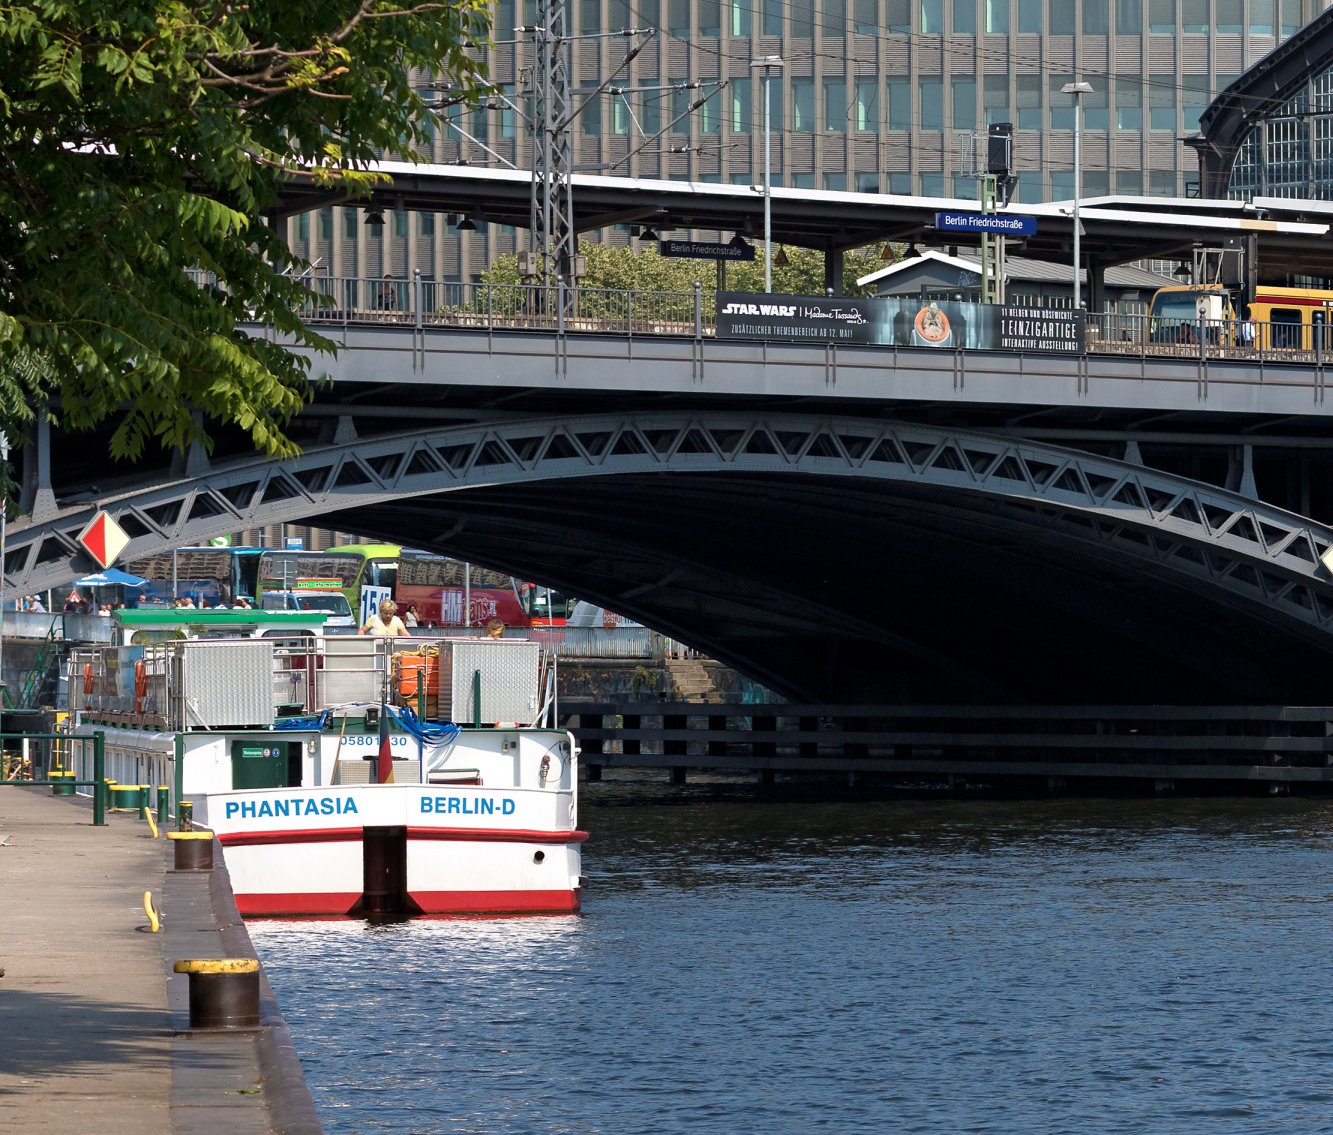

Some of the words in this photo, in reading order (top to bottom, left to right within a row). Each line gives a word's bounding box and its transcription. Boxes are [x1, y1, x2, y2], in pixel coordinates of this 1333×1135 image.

[945, 215, 967, 226] Berlin
[968, 216, 1023, 229] Friedrichstraße
[671, 243, 690, 253] Berlin
[691, 245, 742, 256] Friedrichstraße
[722, 303, 759, 315] STAR
[759, 305, 797, 317] WARS
[1009, 308, 1028, 318] HELDEN
[1029, 310, 1040, 319] UND
[731, 324, 772, 335] ZUSÄTZLICHER
[773, 326, 818, 337] THEMENBEREICH
[1008, 320, 1076, 339] EINZIGARTIGE
[1001, 337, 1037, 348] INTERAKTIVE
[1039, 339, 1079, 351] AUSSTELLUNG!
[225, 796, 359, 819] PHANTASIA
[420, 796, 516, 815] BERLIN-D
